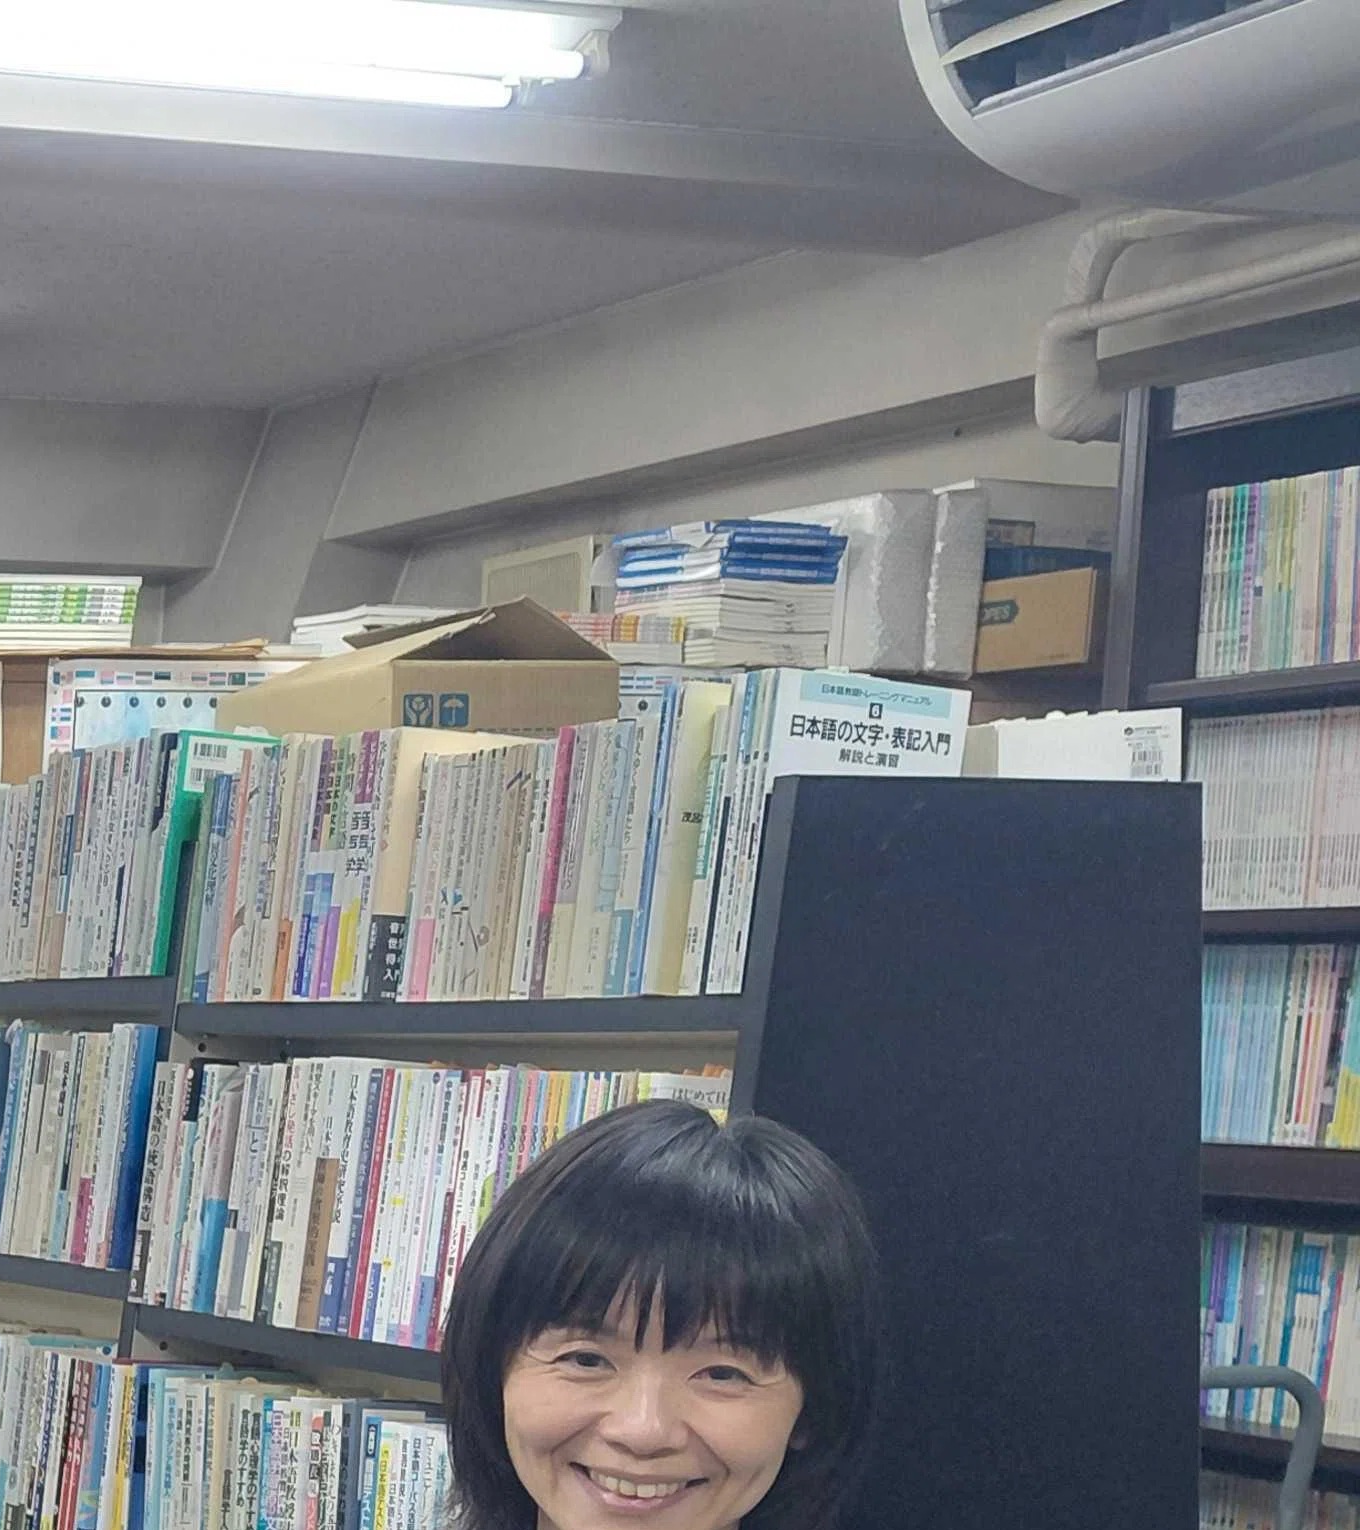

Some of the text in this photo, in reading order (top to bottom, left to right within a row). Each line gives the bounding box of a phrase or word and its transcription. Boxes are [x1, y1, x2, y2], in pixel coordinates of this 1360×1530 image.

[789, 713, 952, 757] 日本語の文字・表記入門
[838, 748, 901, 769] 解説と演習
[236, 1408, 251, 1507] 言語学のすすめ
